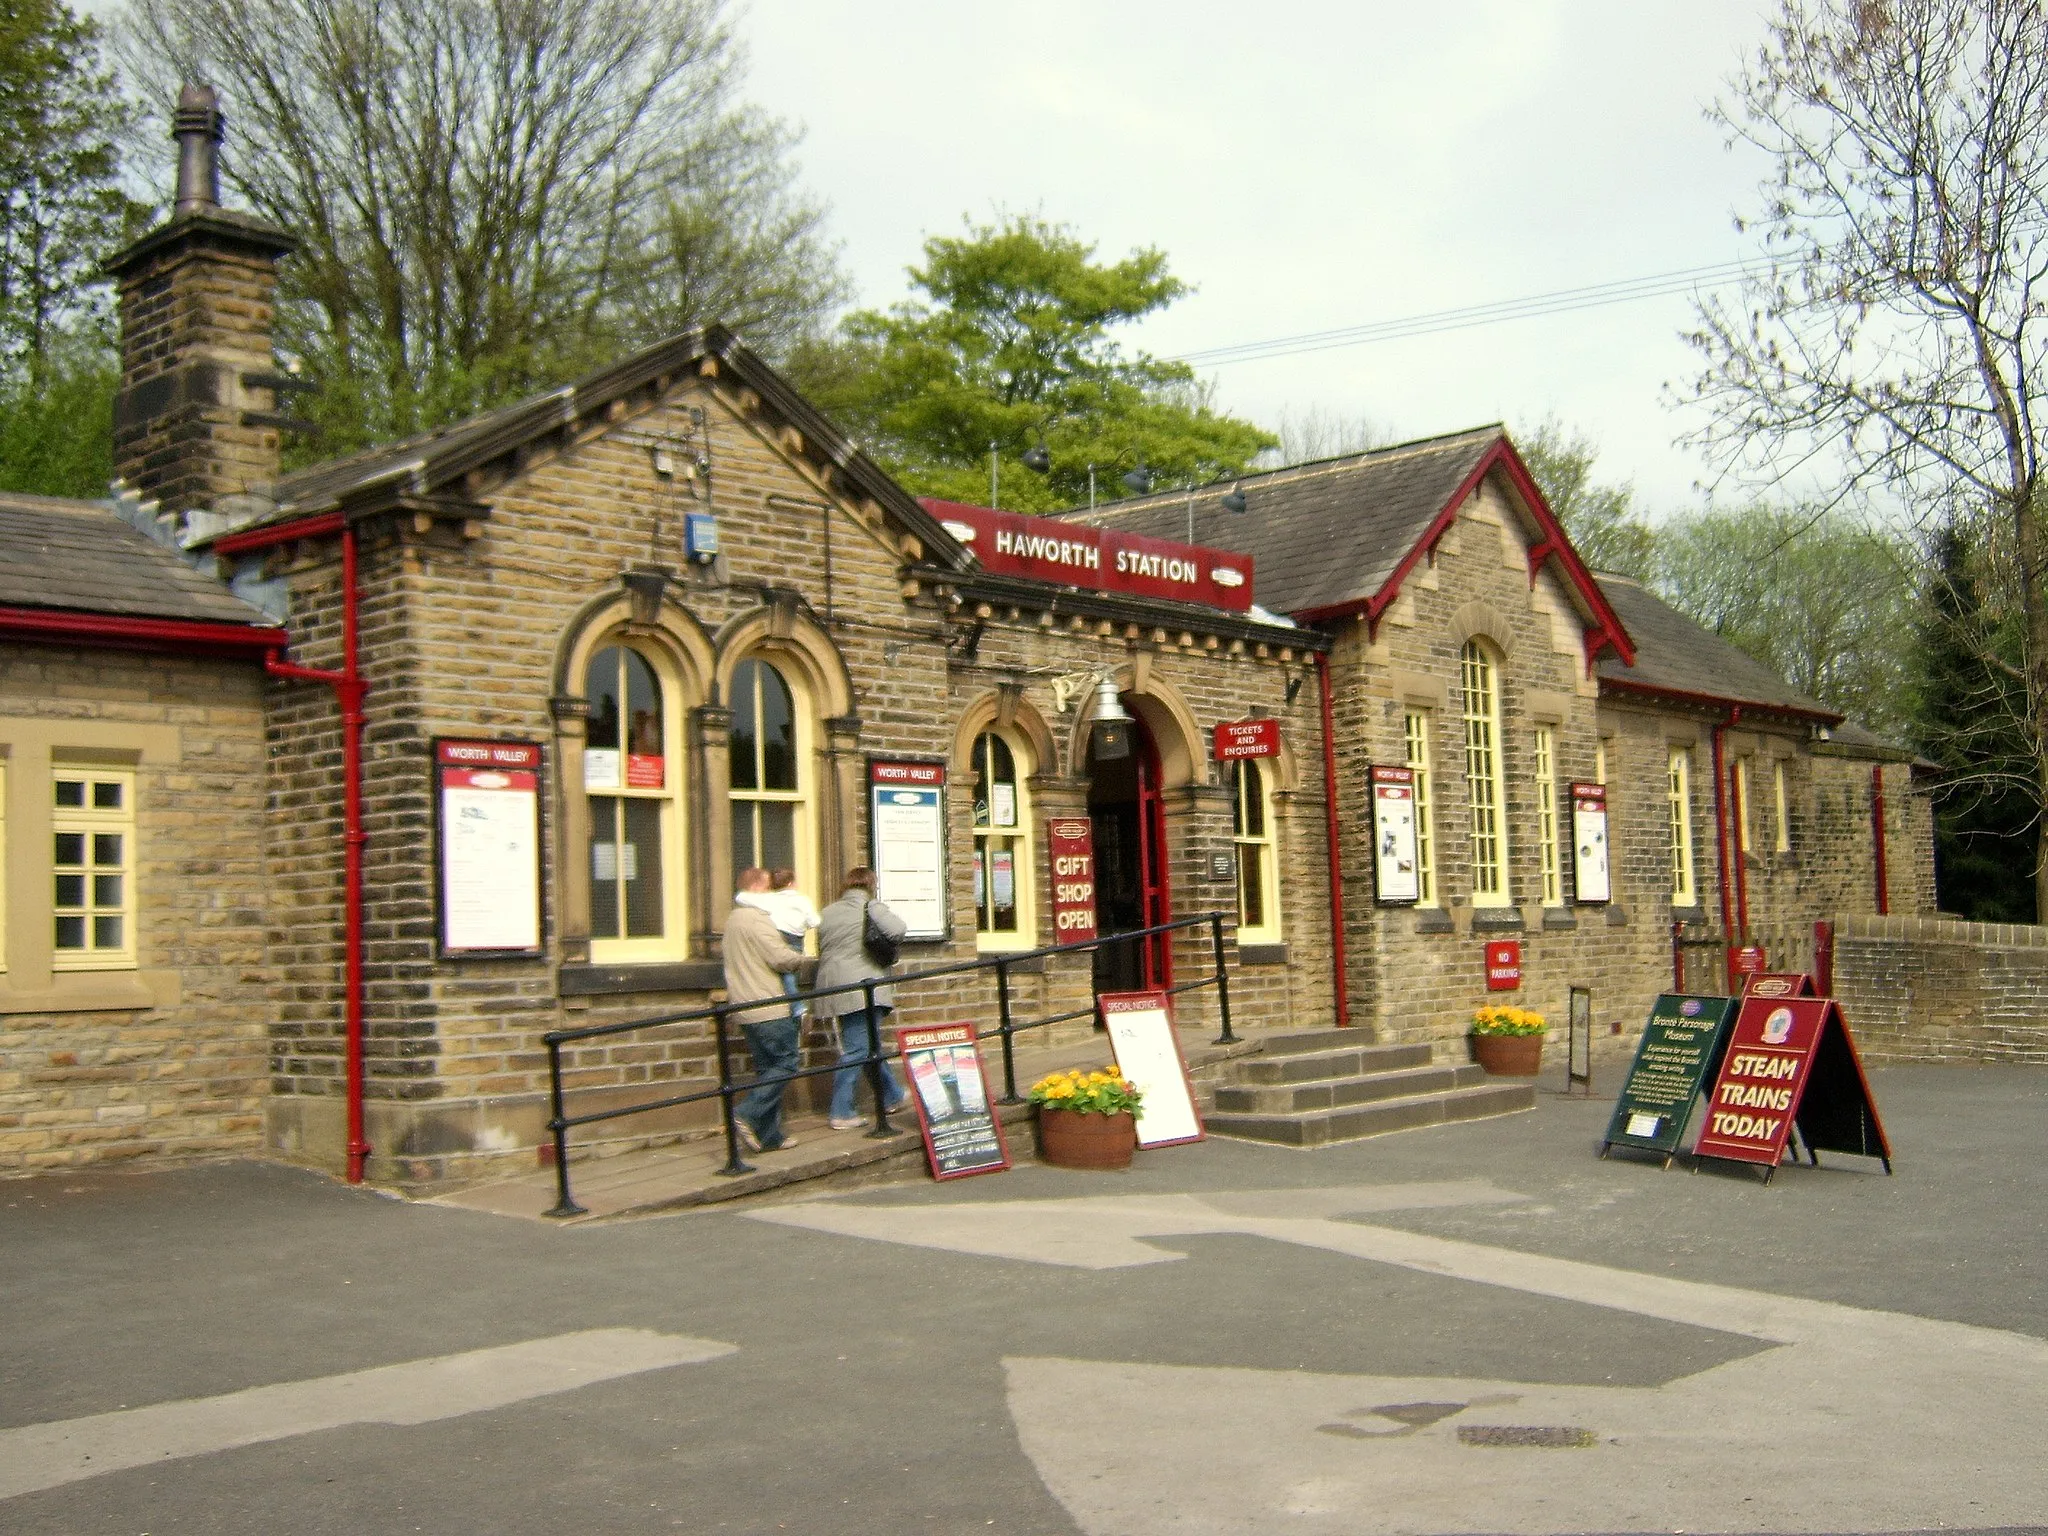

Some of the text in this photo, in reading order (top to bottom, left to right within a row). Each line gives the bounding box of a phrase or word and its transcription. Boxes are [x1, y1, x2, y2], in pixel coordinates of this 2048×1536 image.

[996, 530, 1099, 569] HAWORTH
[1116, 550, 1198, 584] STATION
[1229, 726, 1263, 735] TICKETS
[1236, 736, 1255, 744] AND
[448, 748, 530, 762] WORTH VALLEY
[1224, 745, 1268, 756] ENQUIRIES
[878, 768, 936, 780] WORTH VALLEY
[1056, 856, 1090, 876] GIFT
[1057, 883, 1092, 903] SHOP
[1058, 912, 1093, 930] OPEN
[1498, 952, 1509, 962] NO
[1492, 968, 1518, 978] PARKING
[1107, 998, 1158, 1012] SPECIAL NOTICE
[906, 1029, 967, 1046] SPECIAL NOTICE
[1730, 1055, 1798, 1080] STEAM
[1720, 1083, 1792, 1111] TRAINS
[1712, 1112, 1780, 1140] TODAY
